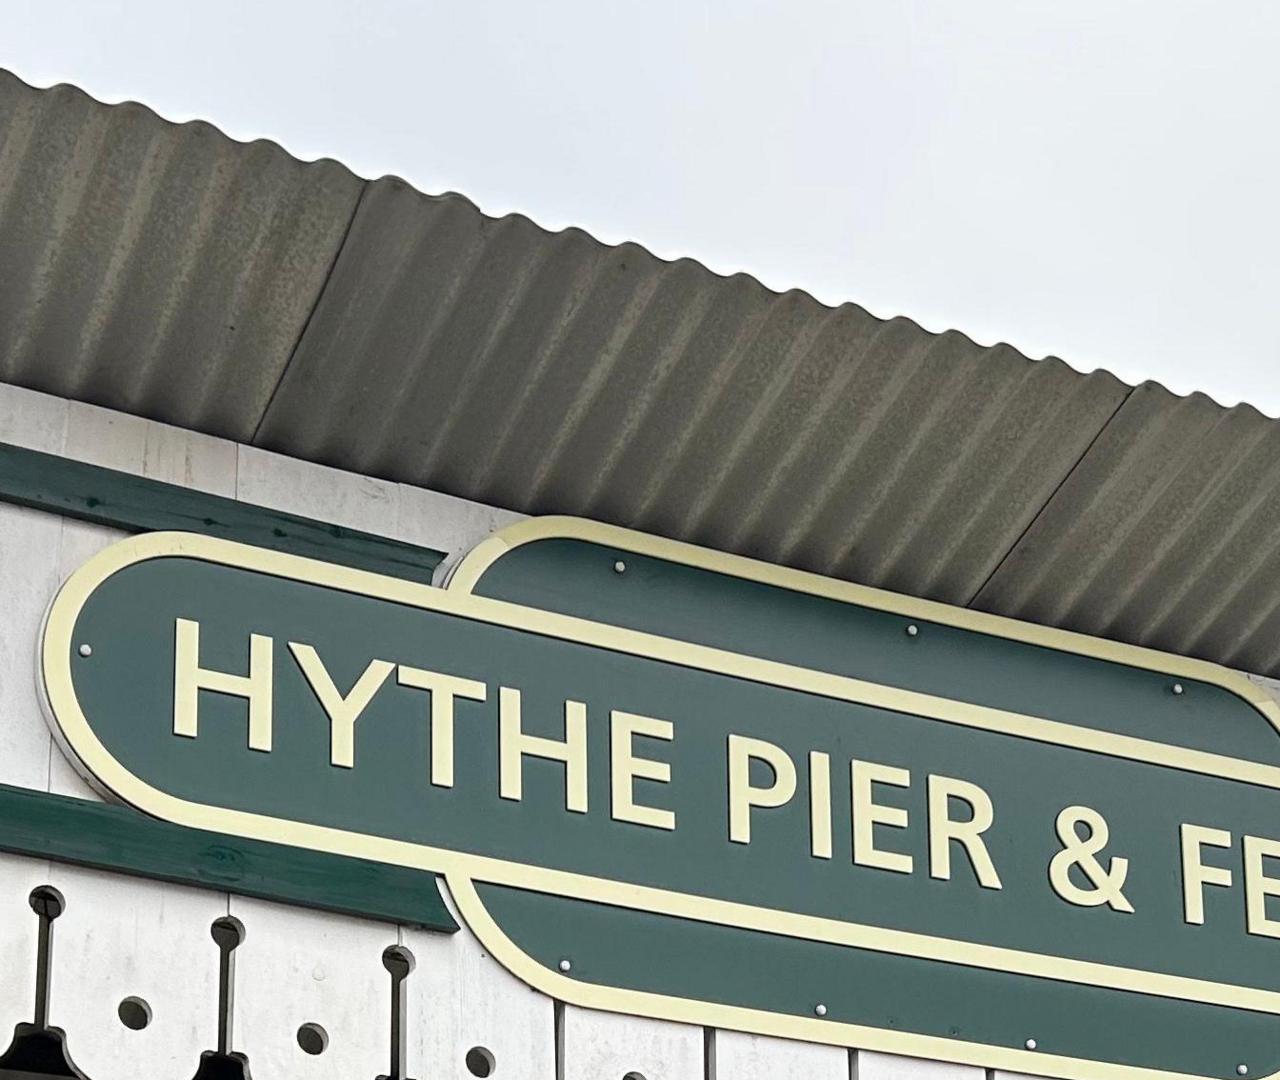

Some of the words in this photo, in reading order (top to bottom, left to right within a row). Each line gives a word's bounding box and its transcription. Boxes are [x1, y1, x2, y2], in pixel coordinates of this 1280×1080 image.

[175, 618, 675, 829] HYTHE
[729, 735, 1002, 889] PIER
[1050, 806, 1134, 912] &
